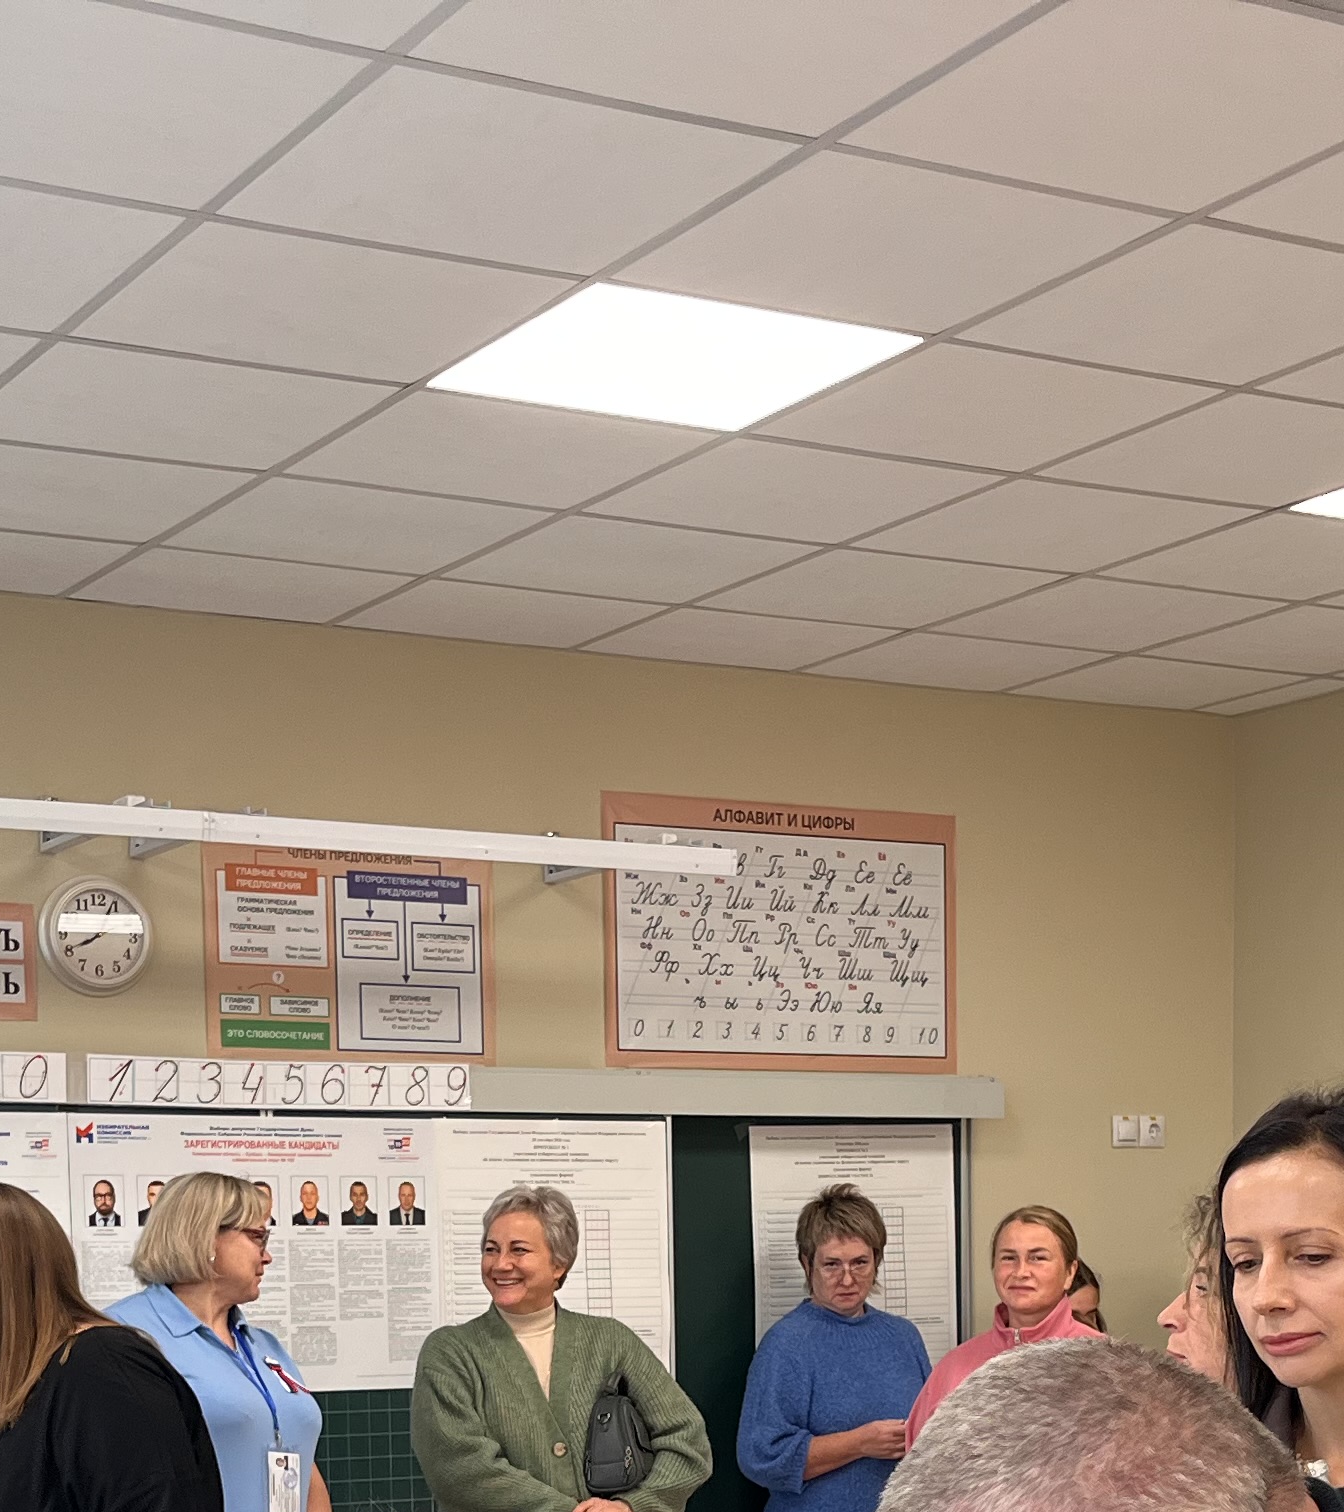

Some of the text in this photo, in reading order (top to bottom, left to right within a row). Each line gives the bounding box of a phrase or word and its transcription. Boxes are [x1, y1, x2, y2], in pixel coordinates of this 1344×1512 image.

[713, 808, 855, 831] АЛФАВИТ И ЦИФРЫ
[288, 848, 413, 866] ЧЛЕНЫ ПРЕДЛОЖЕНИЯ
[76, 899, 89, 911] 11
[90, 894, 107, 906] 12
[64, 945, 74, 957] 8
[123, 948, 131, 960] 4
[78, 959, 87, 971] 7
[95, 964, 104, 977] 6
[113, 960, 120, 973] 5
[3, 972, 20, 994] Ь
[227, 1030, 324, 1040] ЭТО СЛОВОСОЧЕТАНИЕ
[634, 1020, 644, 1036] 0
[667, 1021, 673, 1038] 1
[693, 1021, 704, 1038] 2
[722, 1023, 731, 1039] 3
[752, 1023, 760, 1039] 4
[776, 1024, 787, 1039] 5
[806, 1024, 816, 1041] 6
[834, 1025, 844, 1041] 7
[863, 1027, 871, 1043] 8
[885, 1027, 894, 1043] 9
[19, 1055, 467, 1107] 0 1 2 3 4 5 6 7 8 9
[184, 1140, 340, 1150] ЗАРЕГИСТРИРОВАННЫЕ КАНДИДАТЫ
